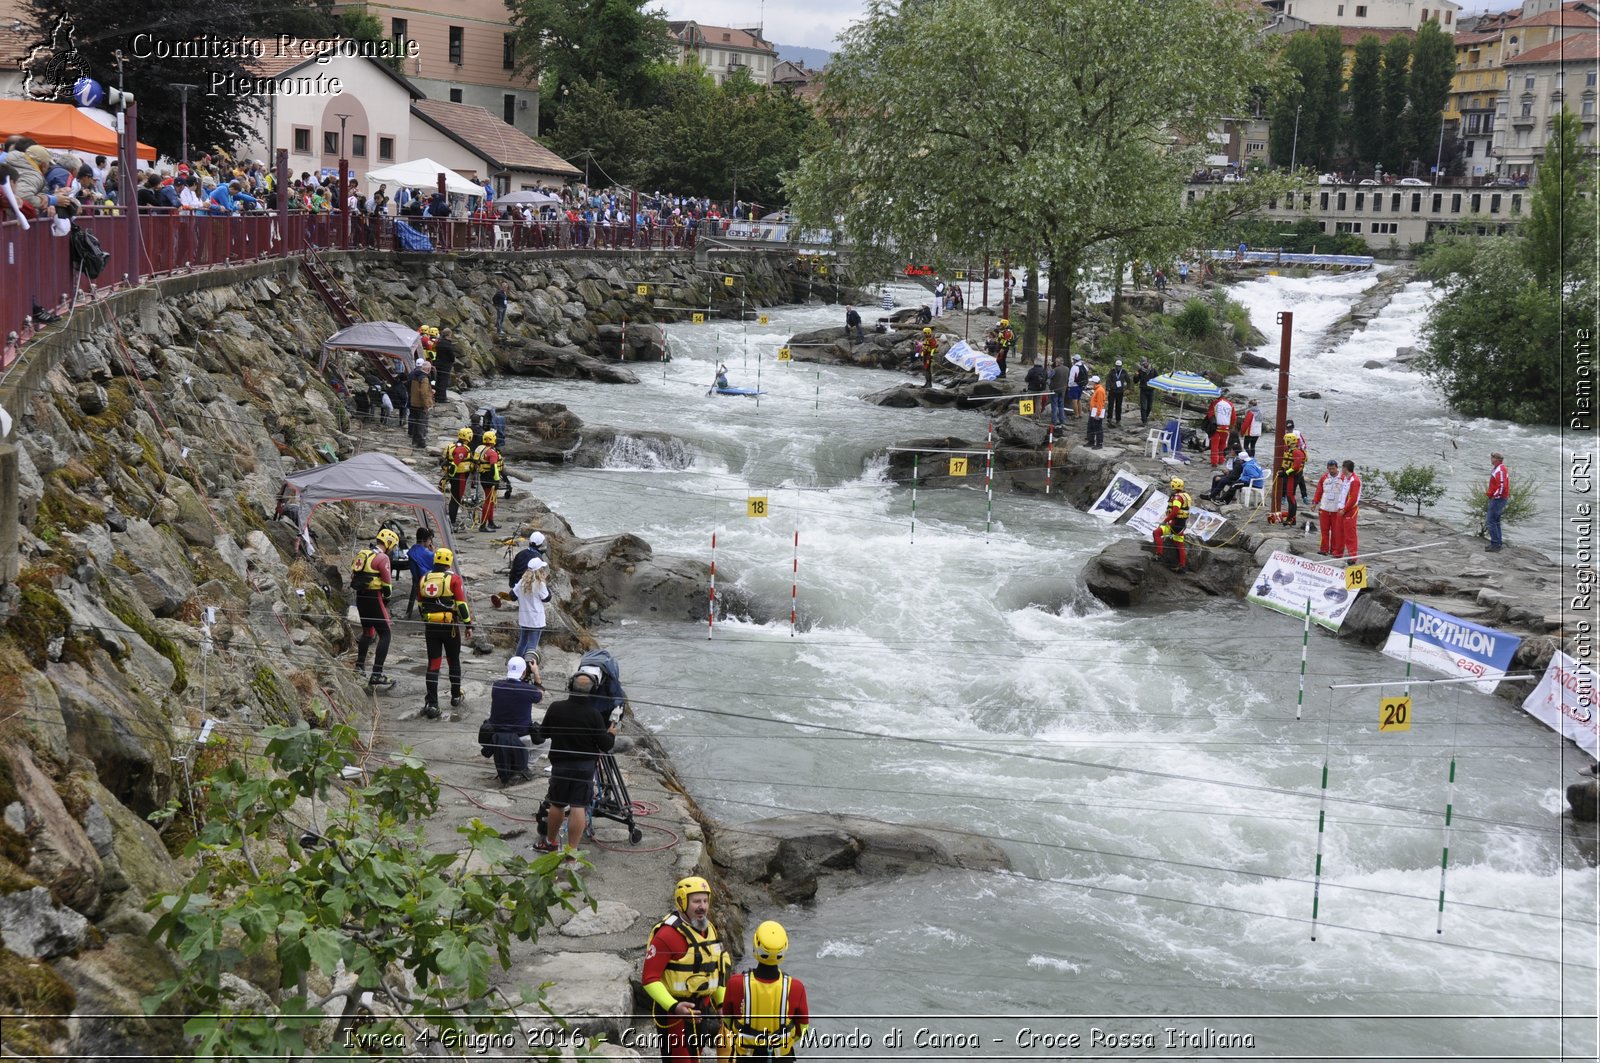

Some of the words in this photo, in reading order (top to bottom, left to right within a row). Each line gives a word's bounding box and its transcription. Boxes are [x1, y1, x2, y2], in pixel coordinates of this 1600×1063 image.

[780, 351, 789, 359] 15
[1022, 403, 1032, 413] 16
[953, 461, 964, 473] 17
[751, 500, 764, 514] 18
[1272, 552, 1297, 567] VENDITA
[1300, 561, 1335, 577] ASSISTENZA
[1349, 569, 1363, 585] 19
[1415, 611, 1496, 658] DECATHLON
[1456, 658, 1487, 679] easy
[1384, 703, 1407, 725] 20
